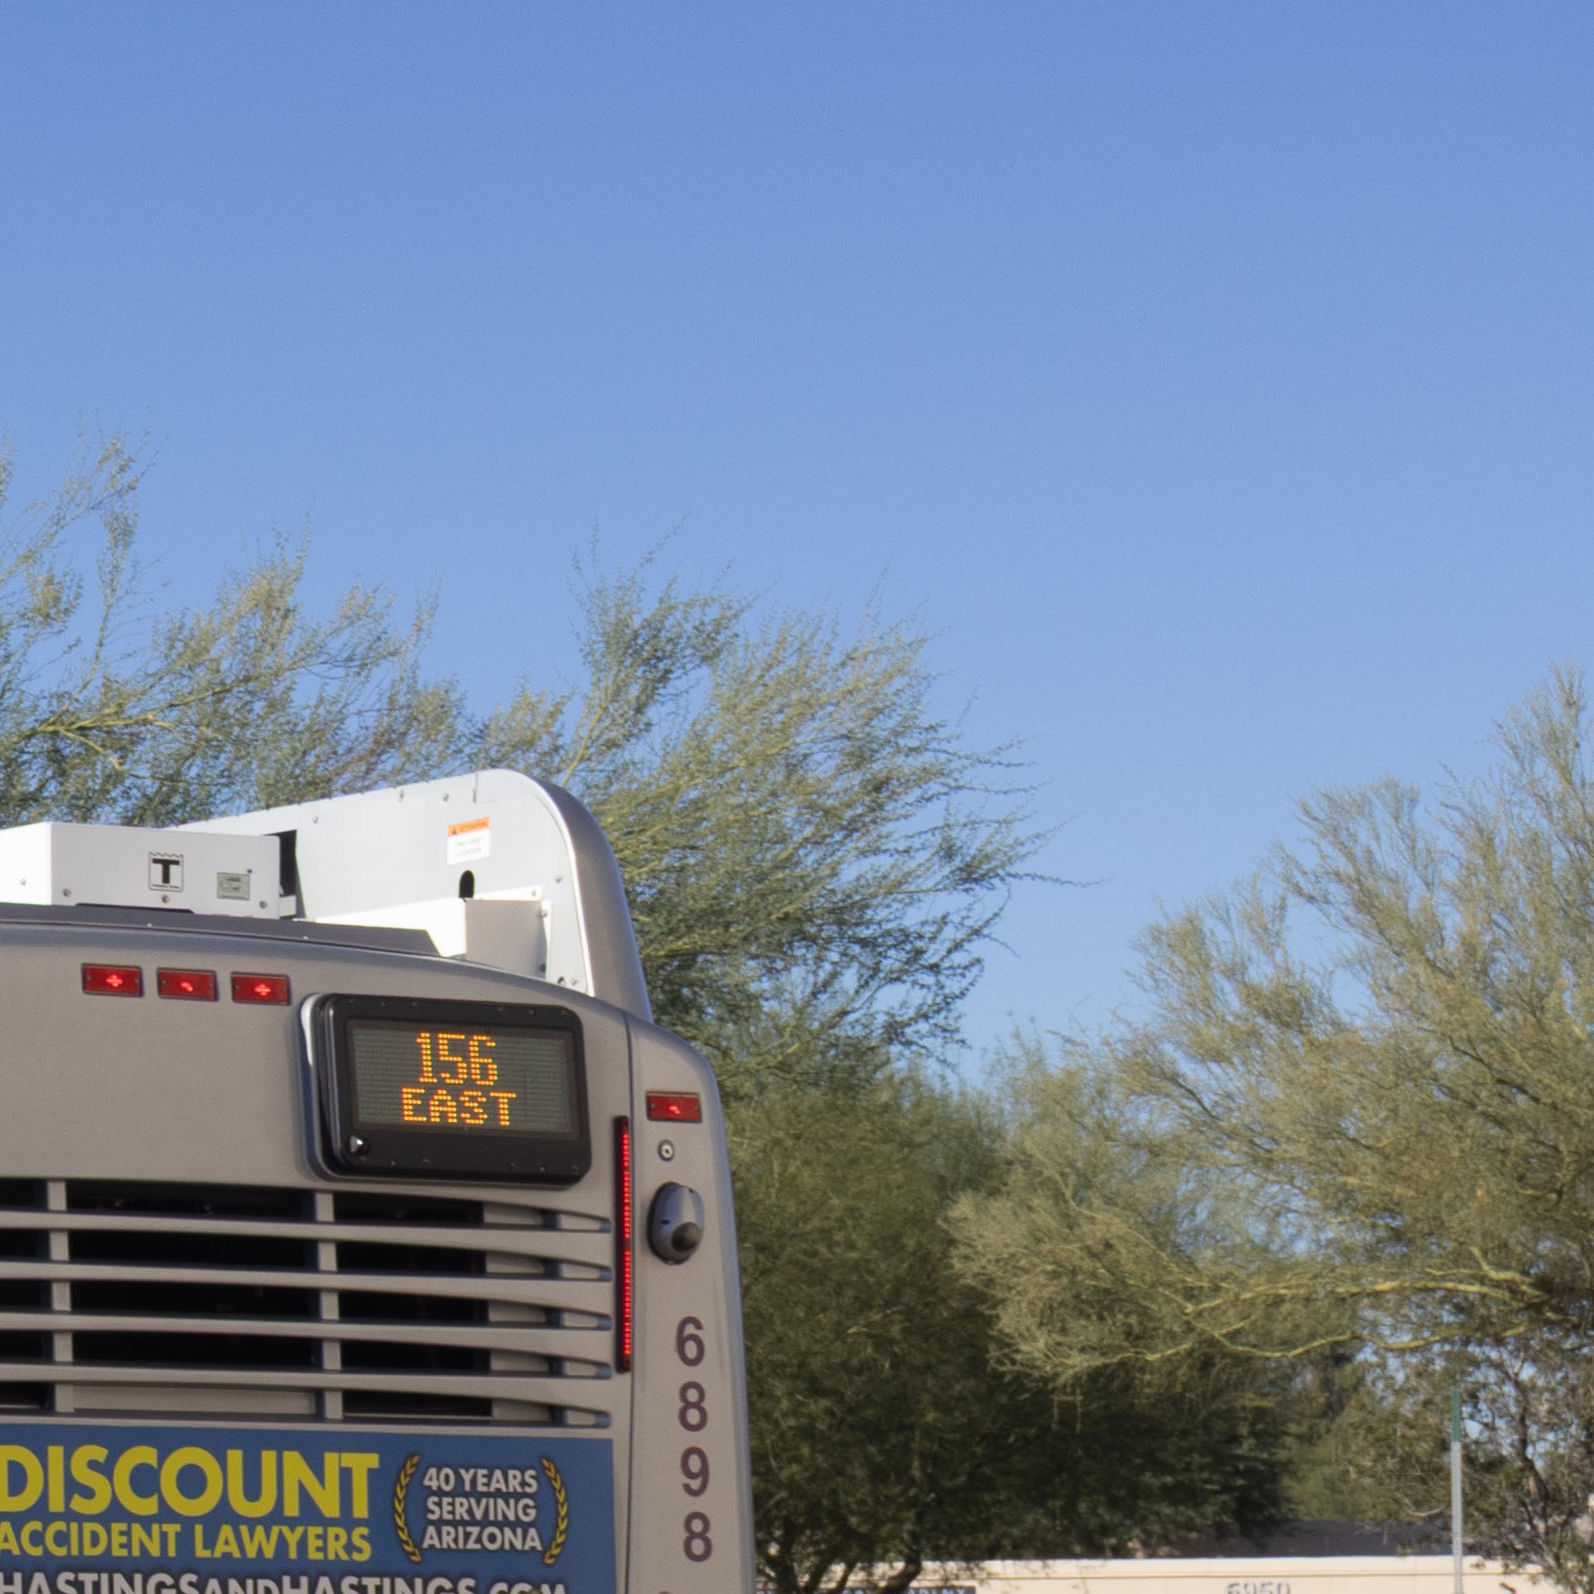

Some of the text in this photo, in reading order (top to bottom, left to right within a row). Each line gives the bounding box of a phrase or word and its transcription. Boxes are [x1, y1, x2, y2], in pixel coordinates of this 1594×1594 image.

[415, 1031, 497, 1086] 156
[401, 1086, 517, 1126] EAST
[676, 1316, 713, 1562] 6898
[423, 1467, 538, 1493] 40 YEARS
[425, 1496, 537, 1522] SERVING
[194, 1523, 373, 1562] LAWYERS
[421, 1526, 543, 1551] ARIZONA
